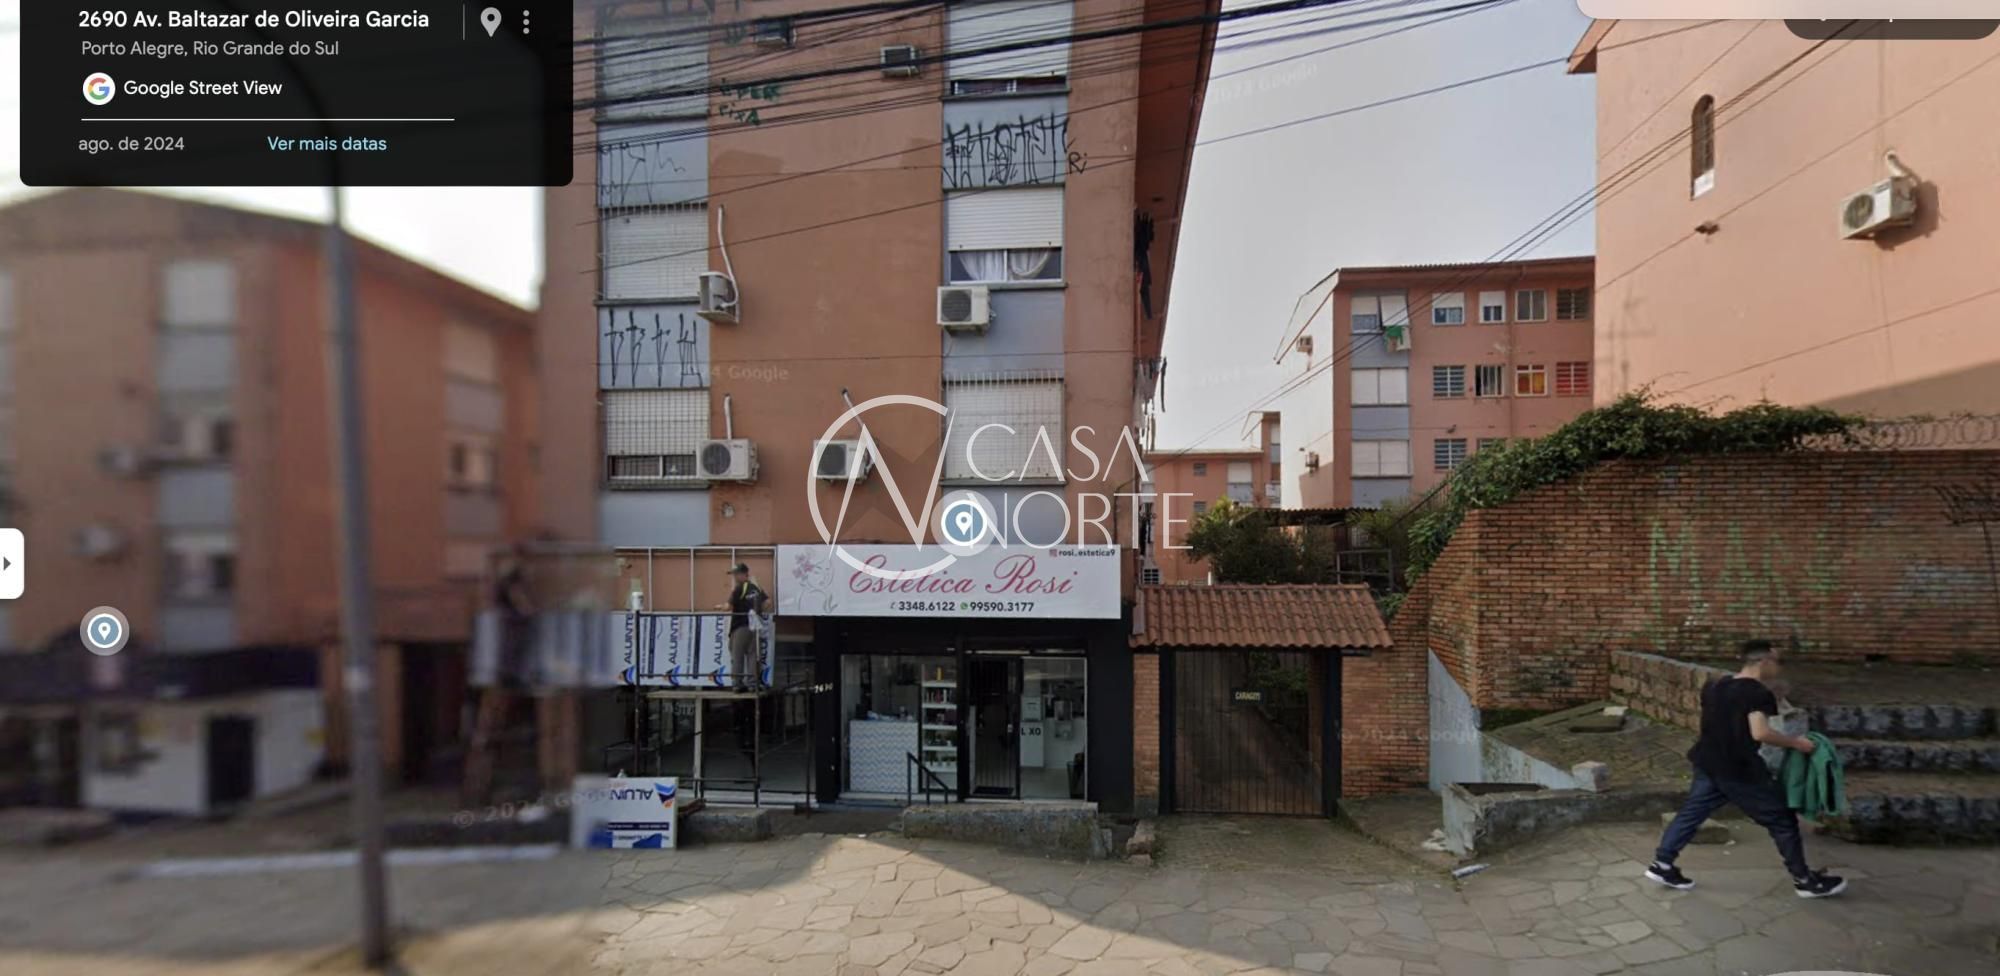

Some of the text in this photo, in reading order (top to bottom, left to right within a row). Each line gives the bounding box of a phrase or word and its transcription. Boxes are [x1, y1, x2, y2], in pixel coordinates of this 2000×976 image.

[985, 554, 1078, 594] Rosi
[898, 601, 956, 612] 3348.6122
[969, 601, 1035, 612] 99590.3177
